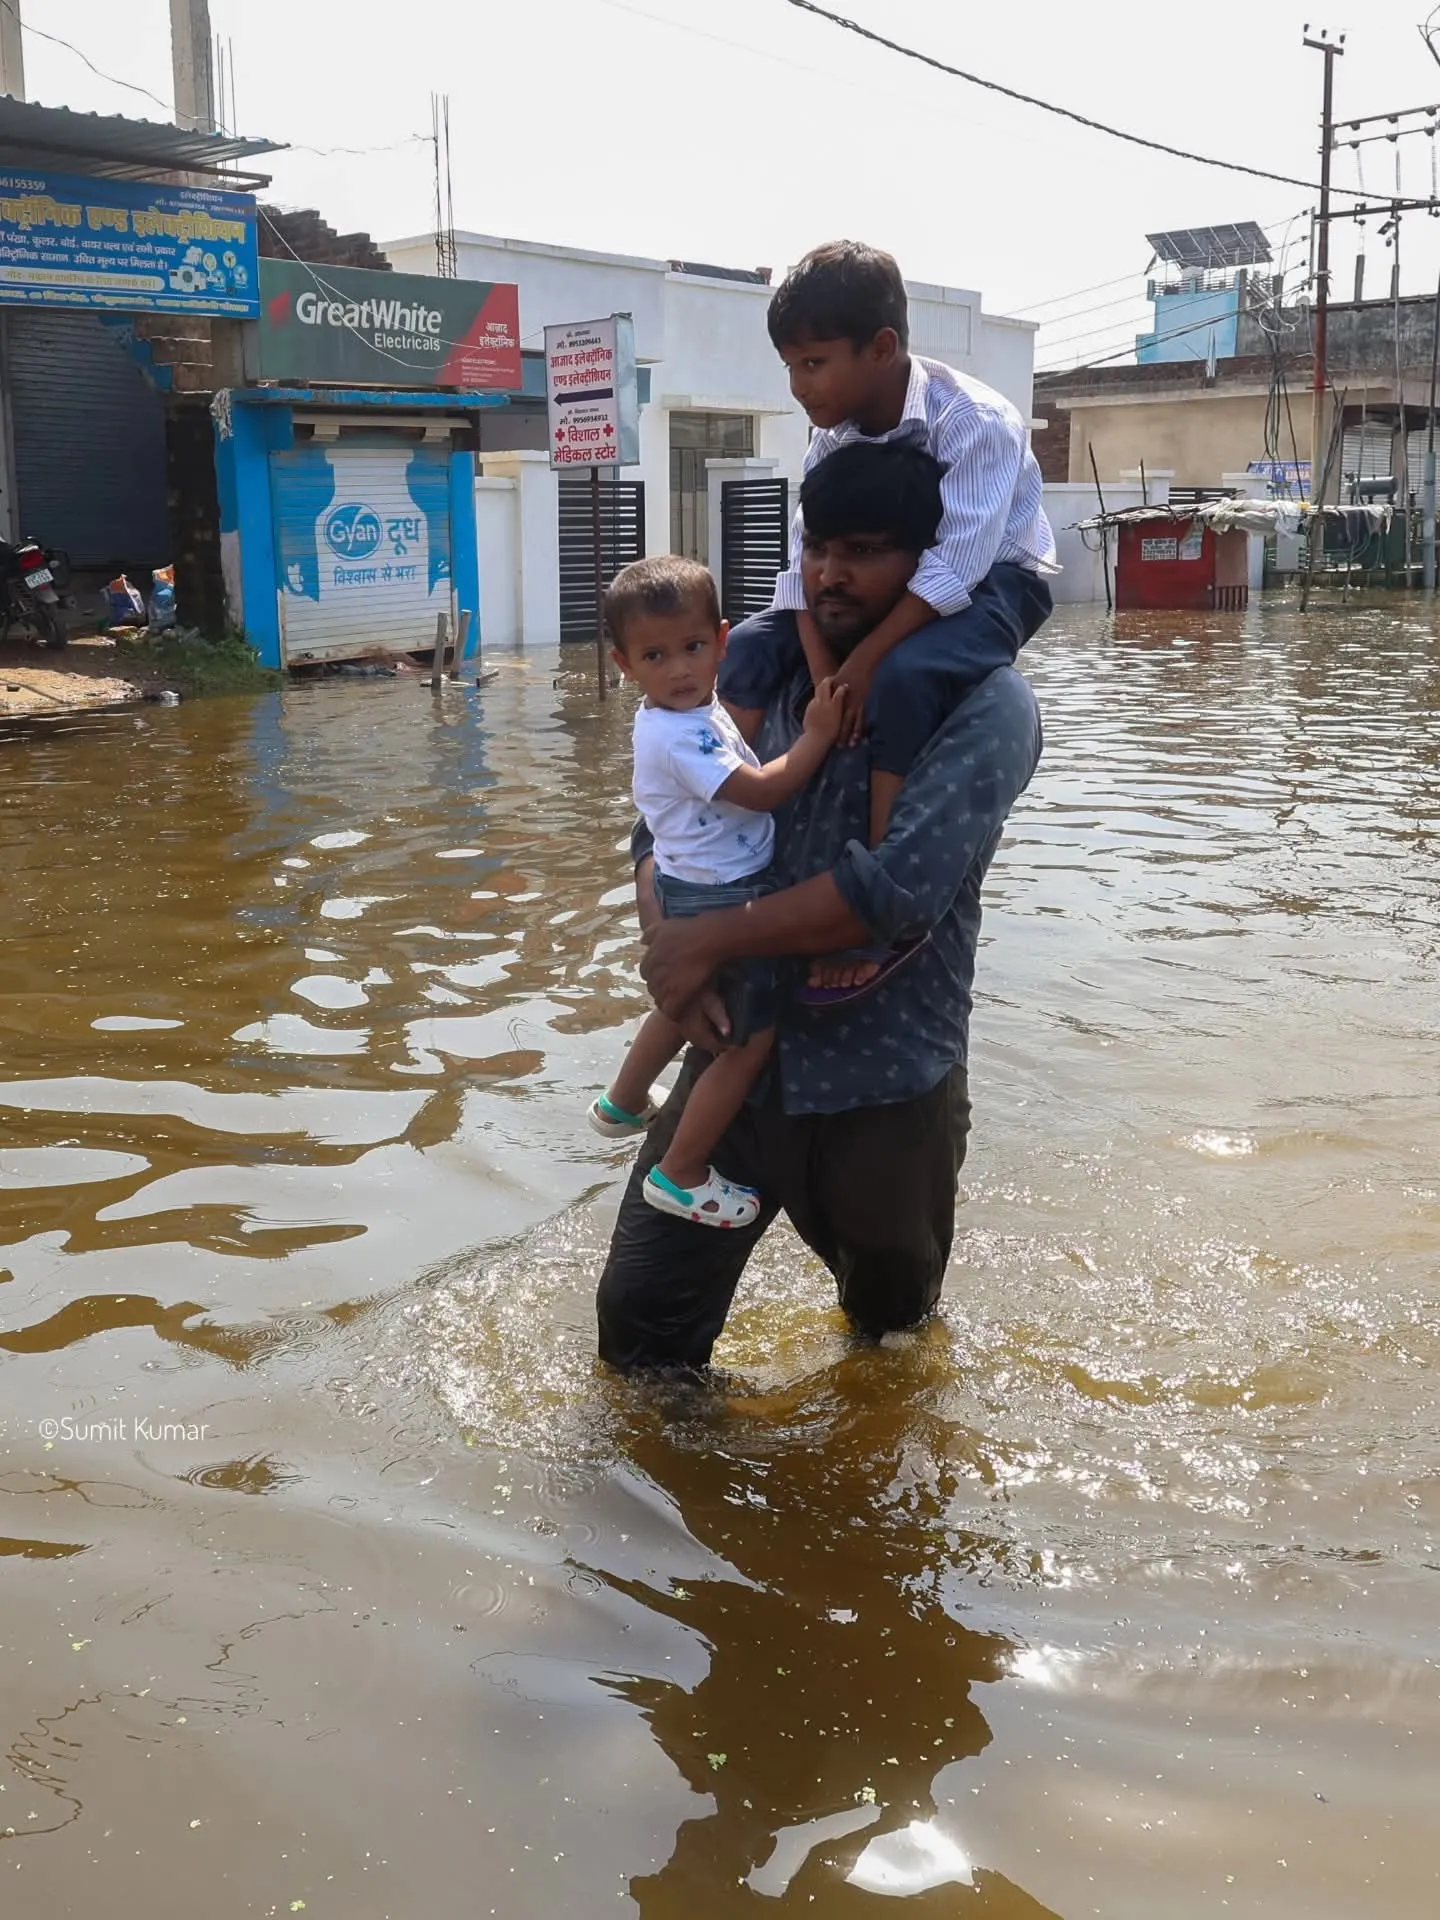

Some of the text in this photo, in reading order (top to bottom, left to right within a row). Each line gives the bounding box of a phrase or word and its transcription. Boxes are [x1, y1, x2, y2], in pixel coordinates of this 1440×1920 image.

[374, 332, 441, 351] Electricals
[568, 425, 600, 442] विशाल
[554, 442, 616, 463] मेडिकल स्टोर
[330, 518, 377, 551] Gyan
[385, 518, 421, 555] दूध
